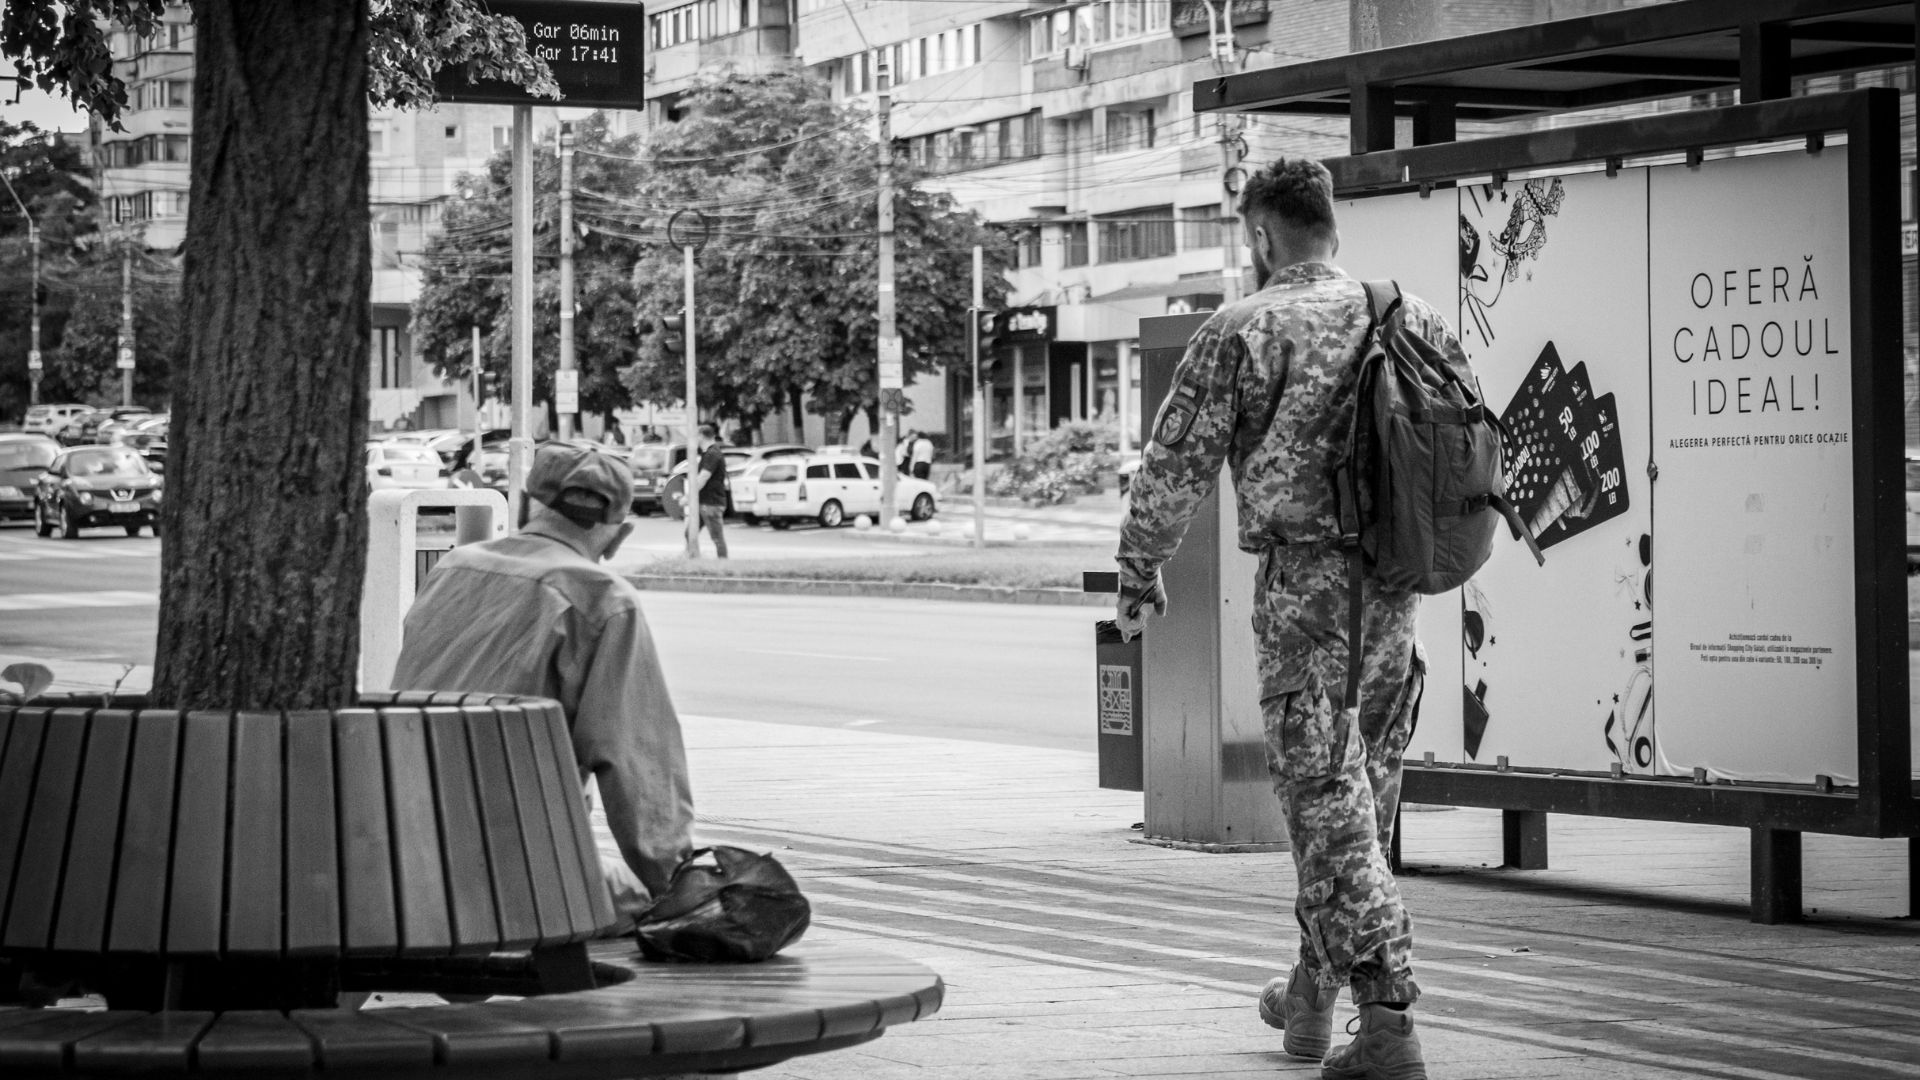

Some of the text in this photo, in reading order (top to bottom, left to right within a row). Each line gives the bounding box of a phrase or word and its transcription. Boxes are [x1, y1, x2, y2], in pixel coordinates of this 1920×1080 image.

[533, 22, 619, 41] Gar 06min
[535, 44, 618, 63] Gar 17:41
[1691, 254, 1818, 309] OFERĂ
[1674, 318, 1839, 363] CADOUL
[1693, 373, 1819, 415] IDEAL!
[1558, 406, 1573, 434] 50
[1568, 426, 1578, 441] LEI
[1580, 430, 1600, 461] 100
[1669, 432, 1848, 448] ALEGEREA PERFECTĂ PENTRU ORICE OCAZIE
[1504, 445, 1531, 495] ARD CADOU
[1590, 454, 1599, 469] LEI
[1600, 467, 1620, 493] 200
[1608, 491, 1617, 505] LEI
